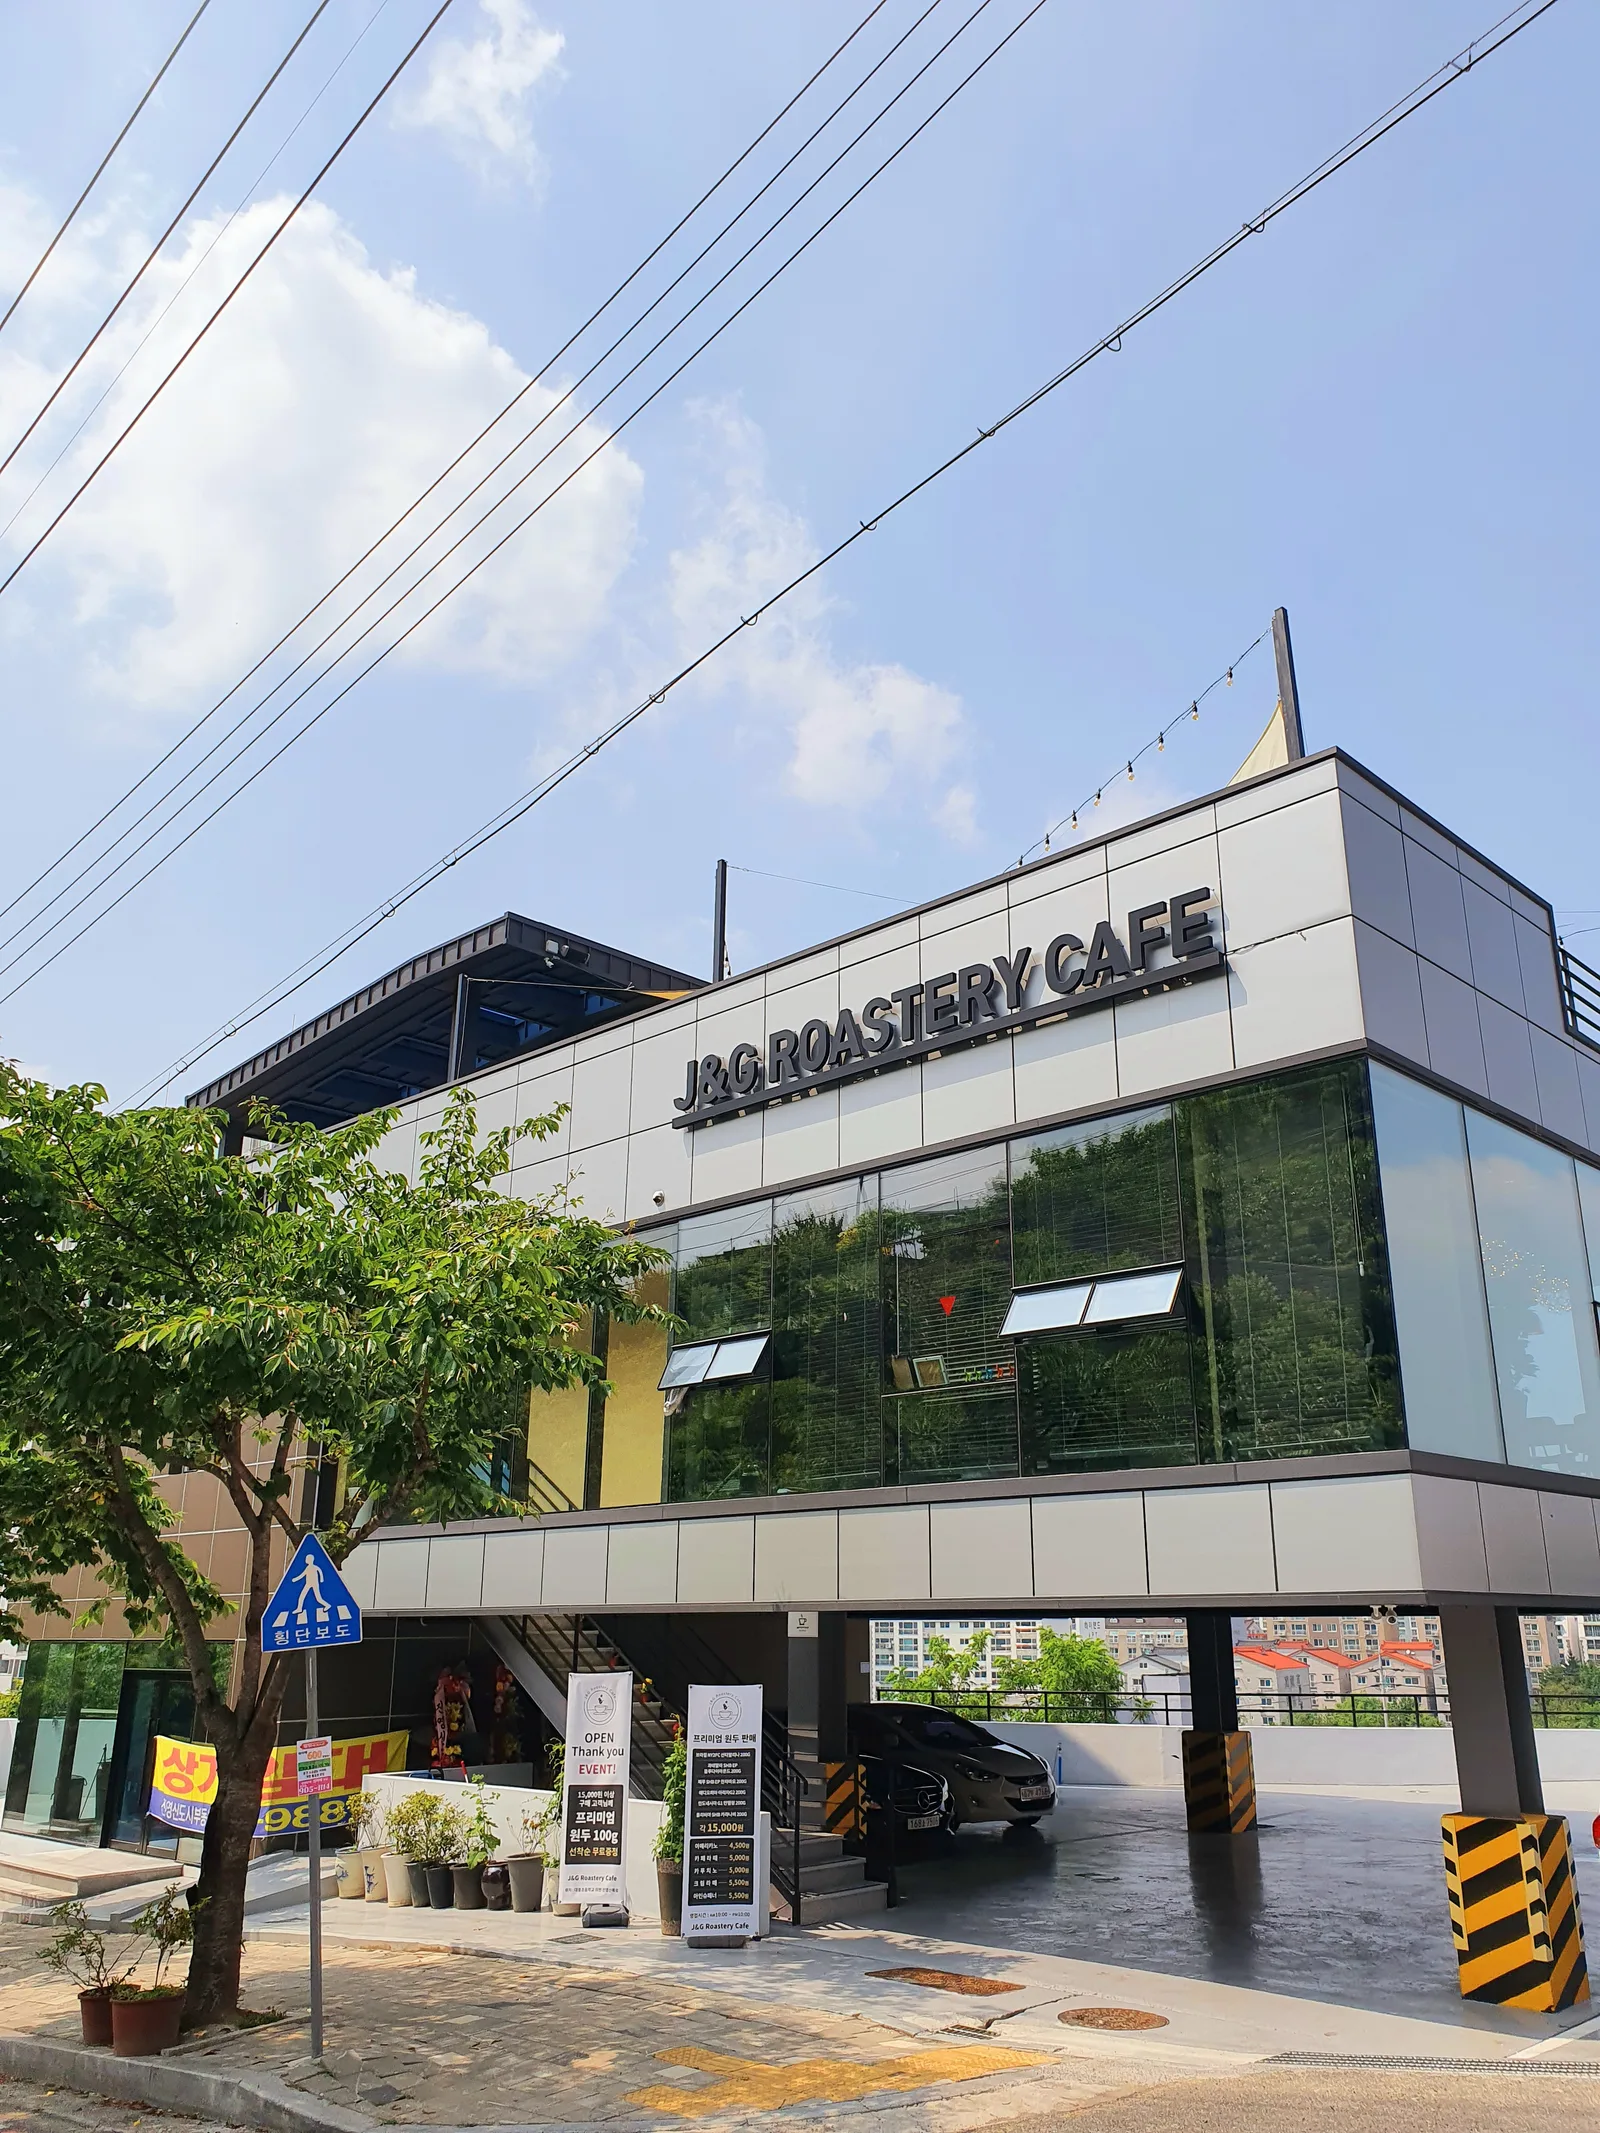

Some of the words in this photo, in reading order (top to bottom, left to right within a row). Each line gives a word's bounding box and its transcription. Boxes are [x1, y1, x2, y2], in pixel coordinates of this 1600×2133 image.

[674, 1043, 759, 1111] J&G
[768, 947, 1032, 1083] ROASTERY
[1044, 887, 1215, 994] CAFE
[274, 1624, 351, 1646] 횡단보도
[585, 1733, 614, 1743] OPEN
[693, 1734, 723, 1744] 프리미엄
[725, 1734, 740, 1743] 원두
[741, 1734, 757, 1743] 판매
[572, 1746, 605, 1757] Thank
[607, 1748, 624, 1759] you
[579, 1764, 616, 1775] EVENT!
[603, 1790, 615, 1799] 이상
[575, 1811, 615, 1825] 프리미엄
[707, 1823, 744, 1834] 15,000원
[569, 1829, 591, 1843] 원두
[592, 1829, 619, 1844] 100g
[569, 1847, 591, 1857] 선착순
